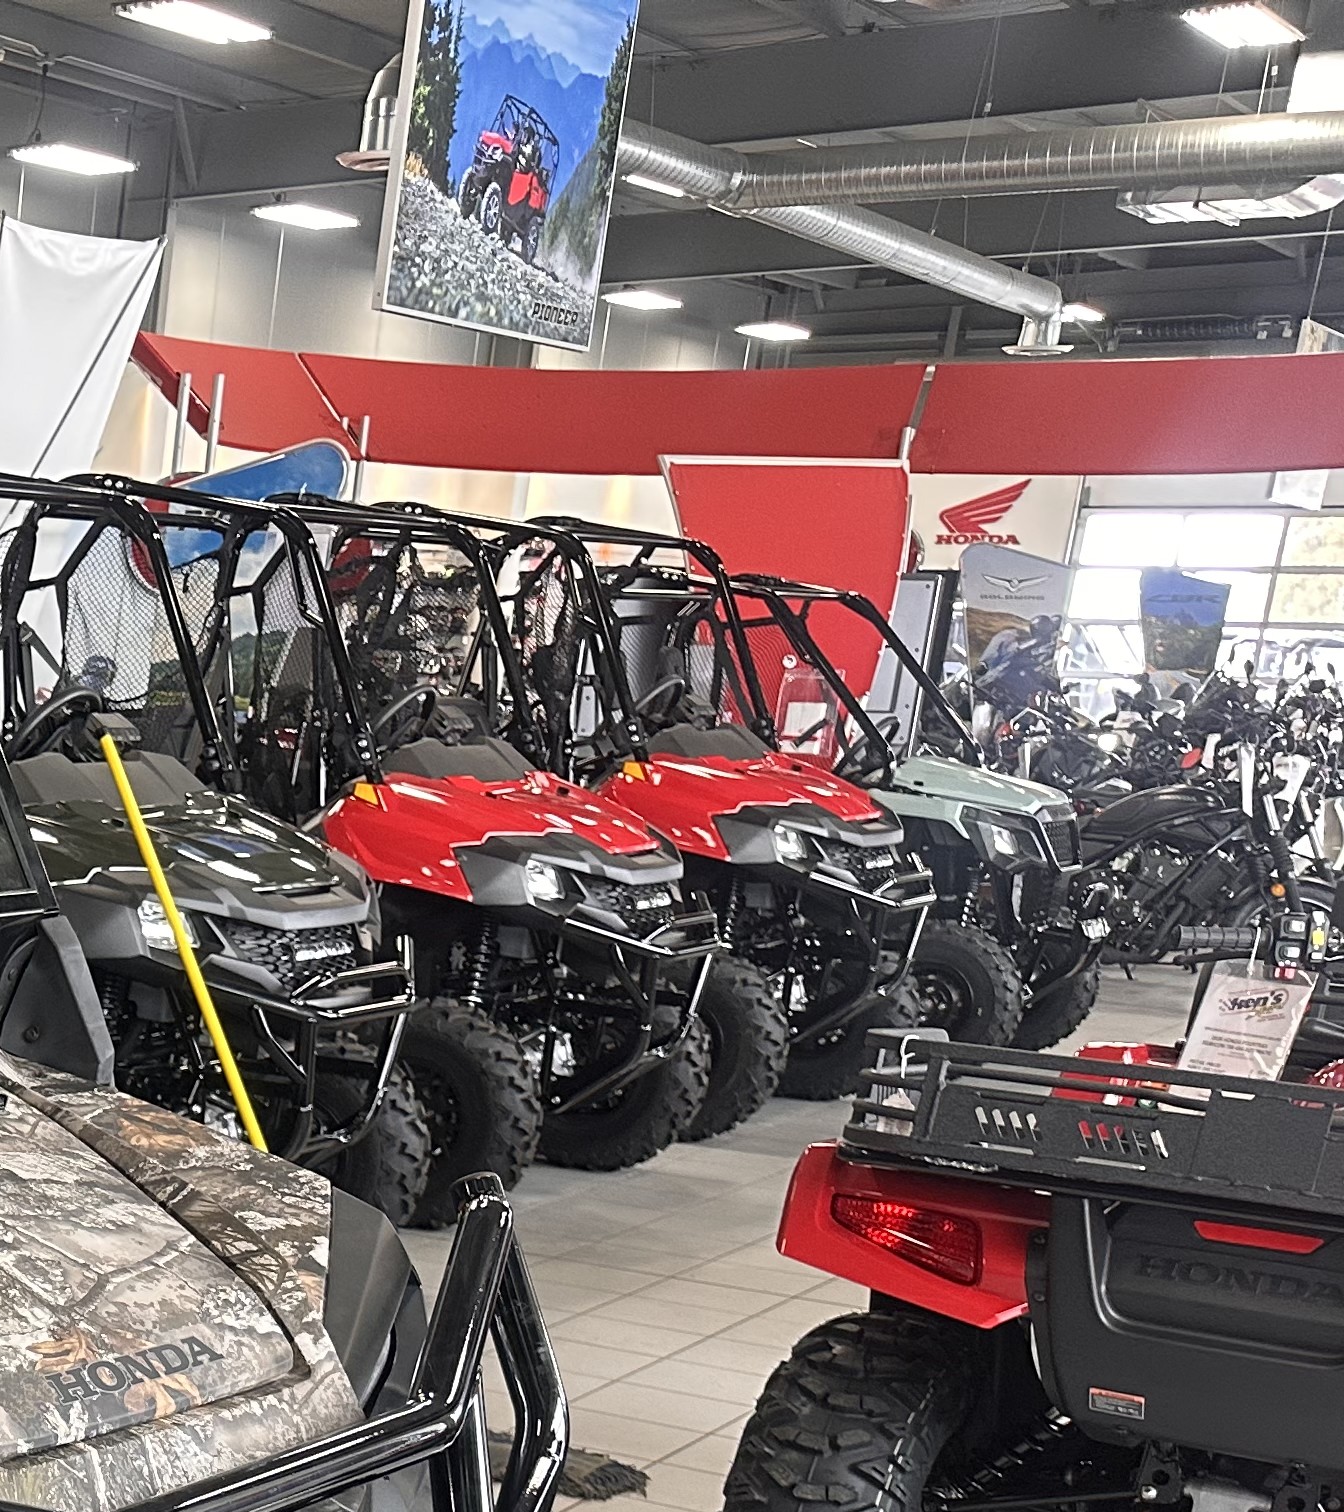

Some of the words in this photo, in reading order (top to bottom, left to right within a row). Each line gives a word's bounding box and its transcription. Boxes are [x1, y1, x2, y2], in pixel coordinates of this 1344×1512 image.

[531, 301, 579, 327] PIONEER
[934, 534, 1021, 546] HONDA
[1137, 1253, 1344, 1302] HONDA
[45, 1335, 225, 1404] HONDA
